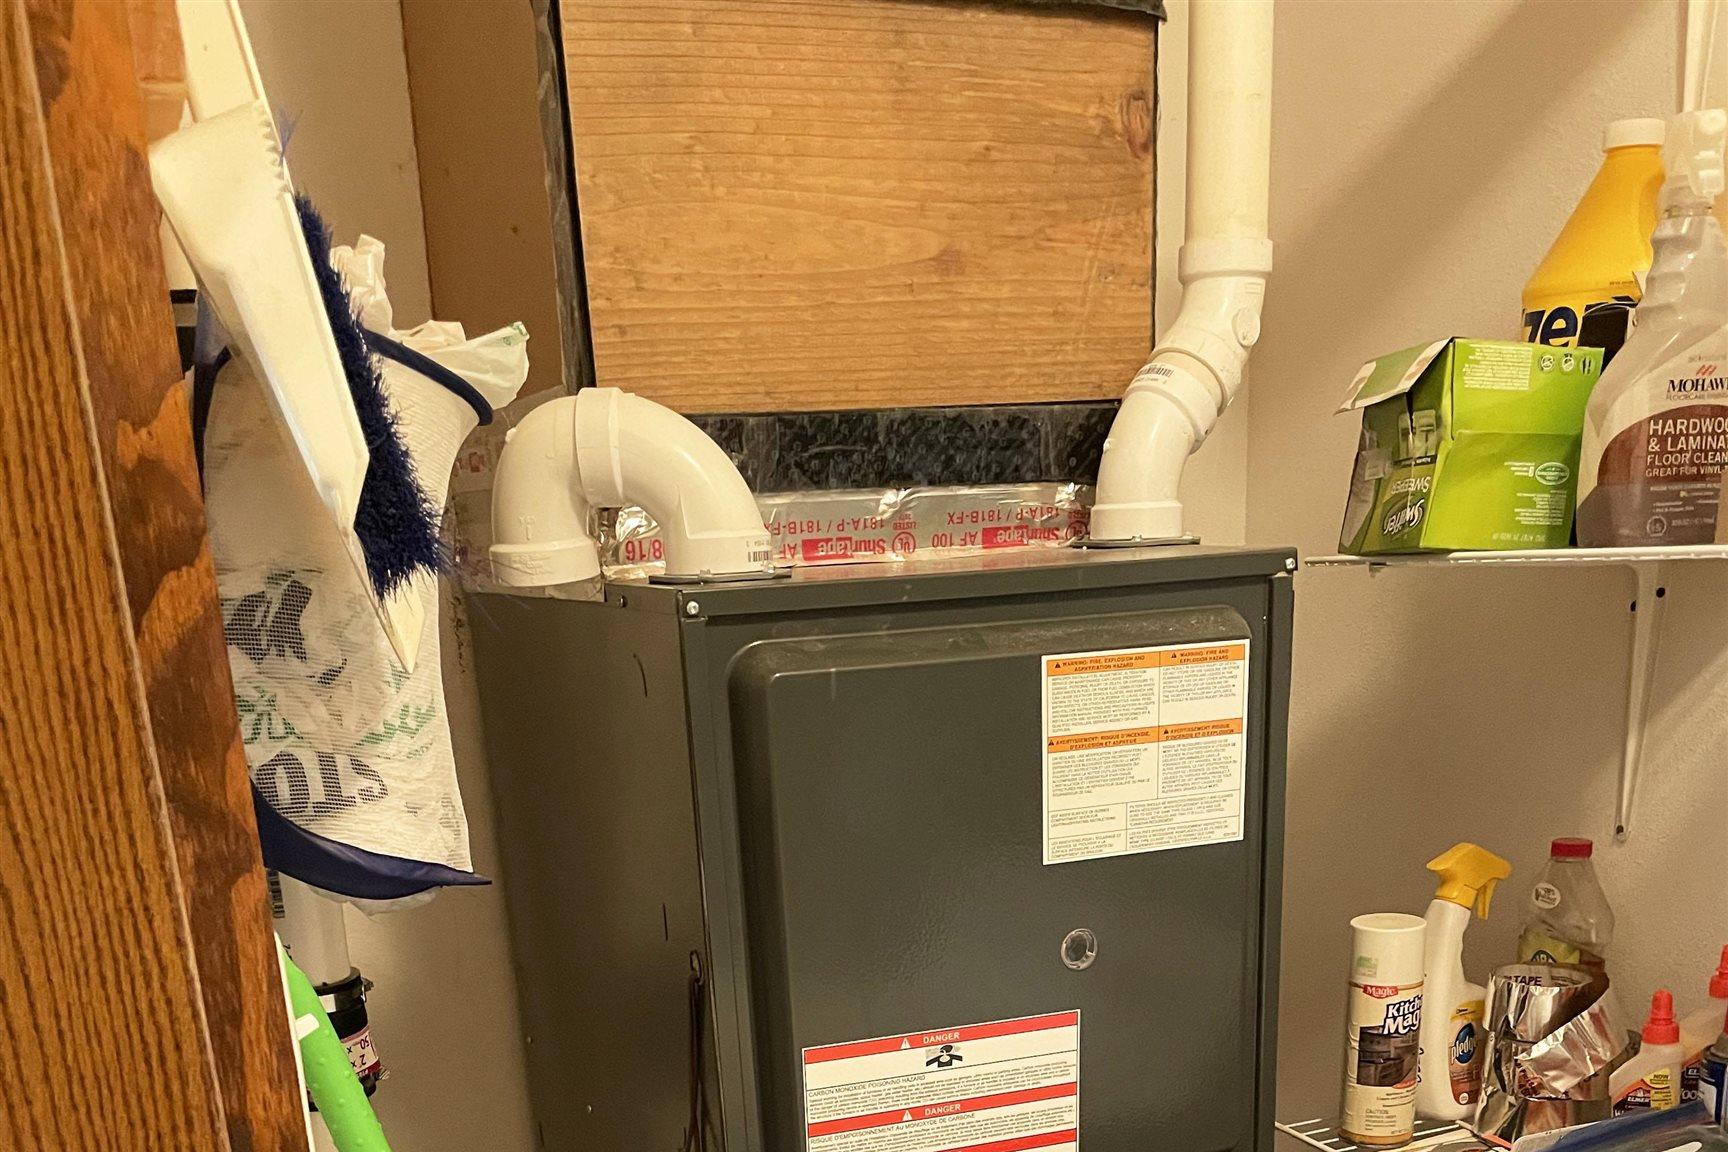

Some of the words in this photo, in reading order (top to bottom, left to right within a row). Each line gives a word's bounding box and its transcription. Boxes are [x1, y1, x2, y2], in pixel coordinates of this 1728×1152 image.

[1648, 438, 1660, 451] &
[1647, 452, 1690, 466] FLOOR
[1645, 468, 1677, 477] GREAT
[947, 509, 1002, 525] 181B-FX
[837, 517, 885, 532] 181A-P
[931, 534, 953, 547] 100
[960, 531, 978, 546] AF
[625, 538, 665, 561] 8/16
[779, 543, 798, 559] AF
[818, 536, 886, 556] Shurtape
[1514, 975, 1543, 986] TAPE
[1366, 986, 1395, 997] Magic
[923, 1031, 960, 1044] DANGER
[924, 1103, 962, 1116] DANGER
